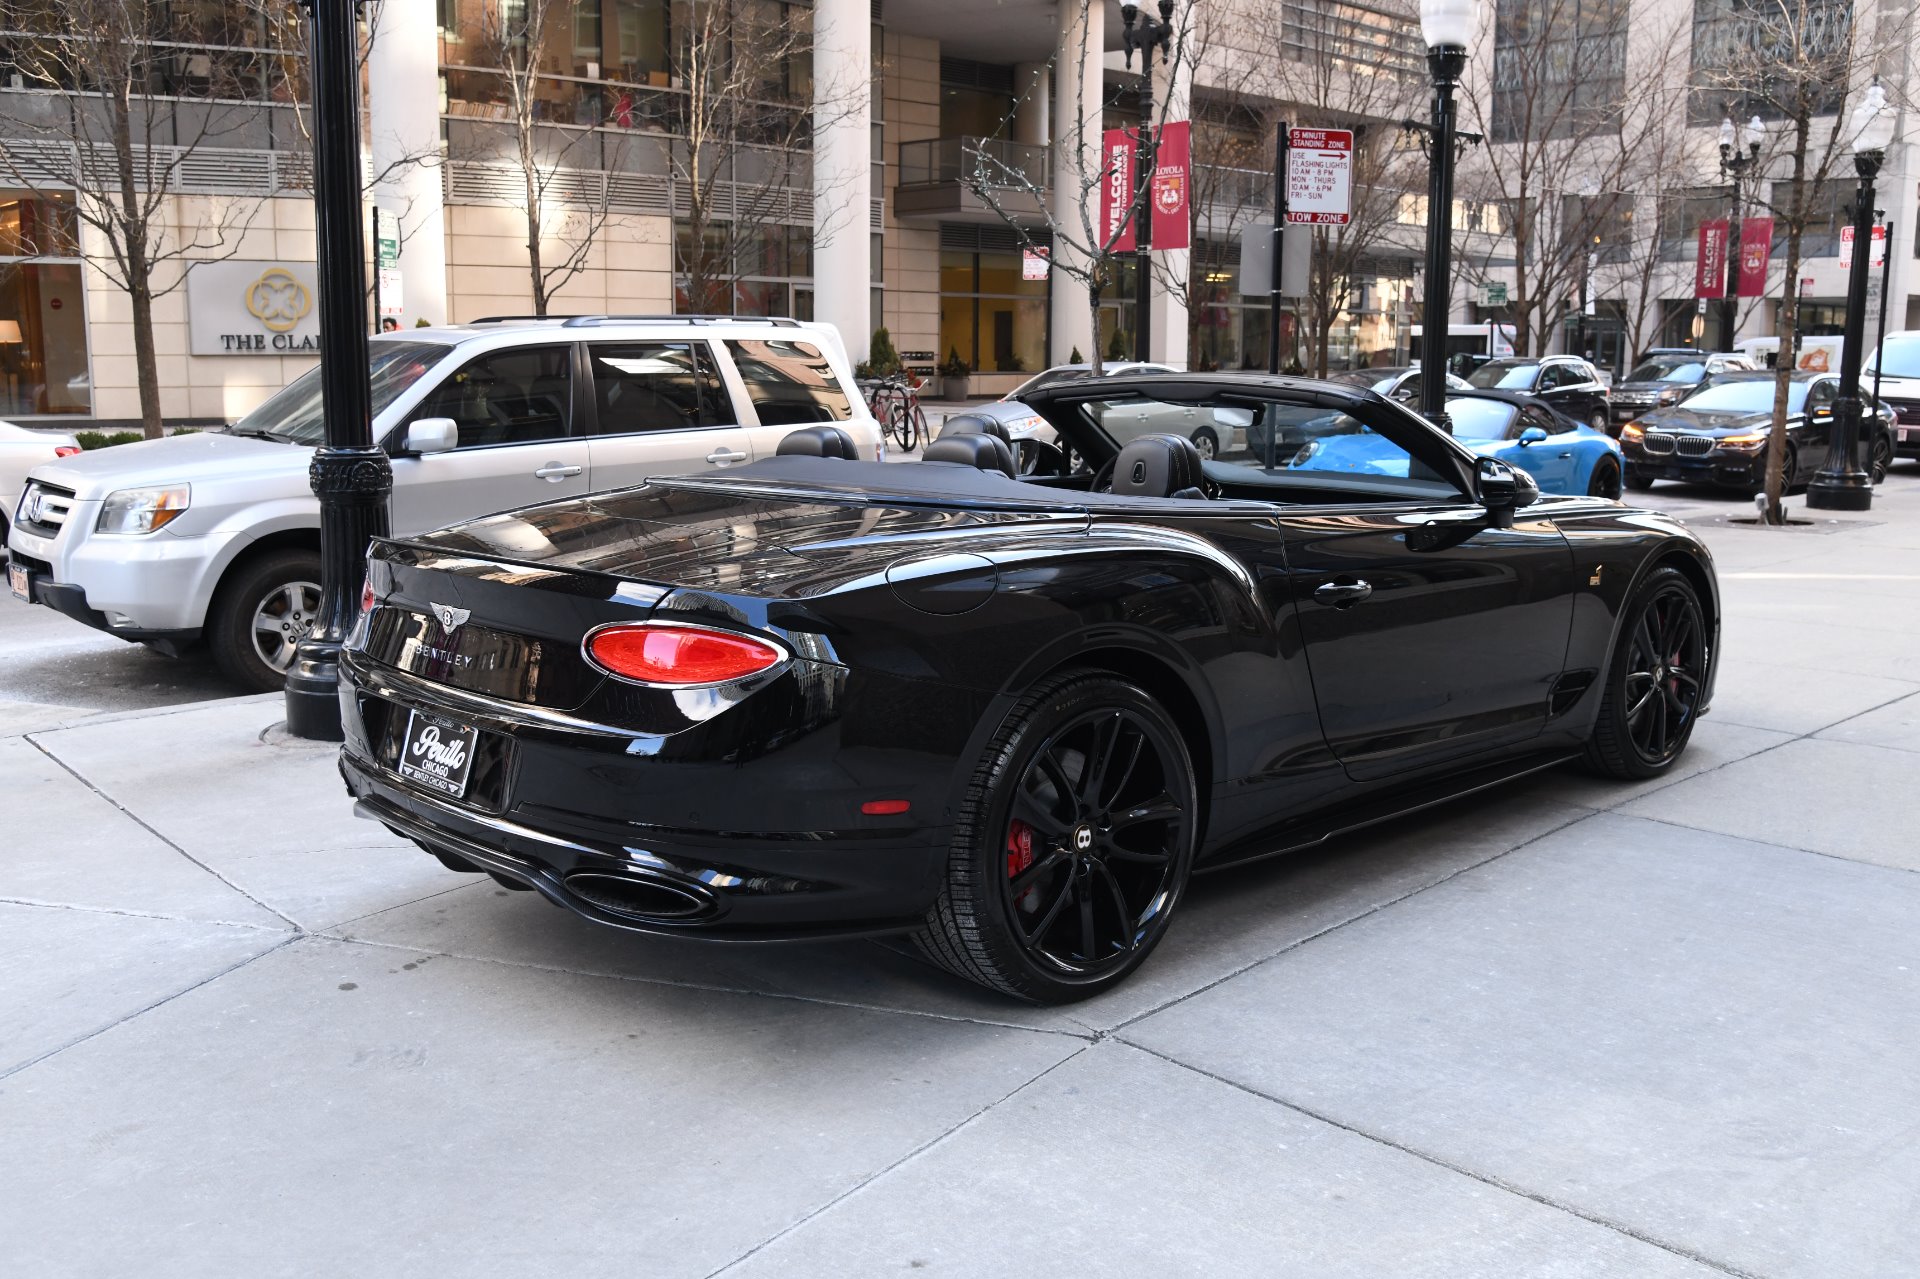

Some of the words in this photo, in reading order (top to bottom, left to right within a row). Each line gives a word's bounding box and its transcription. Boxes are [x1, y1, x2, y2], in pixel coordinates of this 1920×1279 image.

[1302, 132, 1326, 140] MINUTE
[1293, 139, 1325, 148] STANDING
[1327, 141, 1345, 149] ZONE
[1156, 166, 1184, 175] LOYOLA
[1292, 160, 1323, 168] FLASHING
[1110, 145, 1123, 237] WELCOME
[1291, 213, 1312, 222] TOW
[1317, 214, 1343, 224] ZONE
[221, 335, 266, 350] THE
[416, 645, 472, 668] BENTLEY
[413, 726, 466, 770] Perillo
[422, 759, 449, 778] CHICAGO
[413, 770, 429, 782] BENTLEY
[429, 776, 448, 789] CHICAGO
